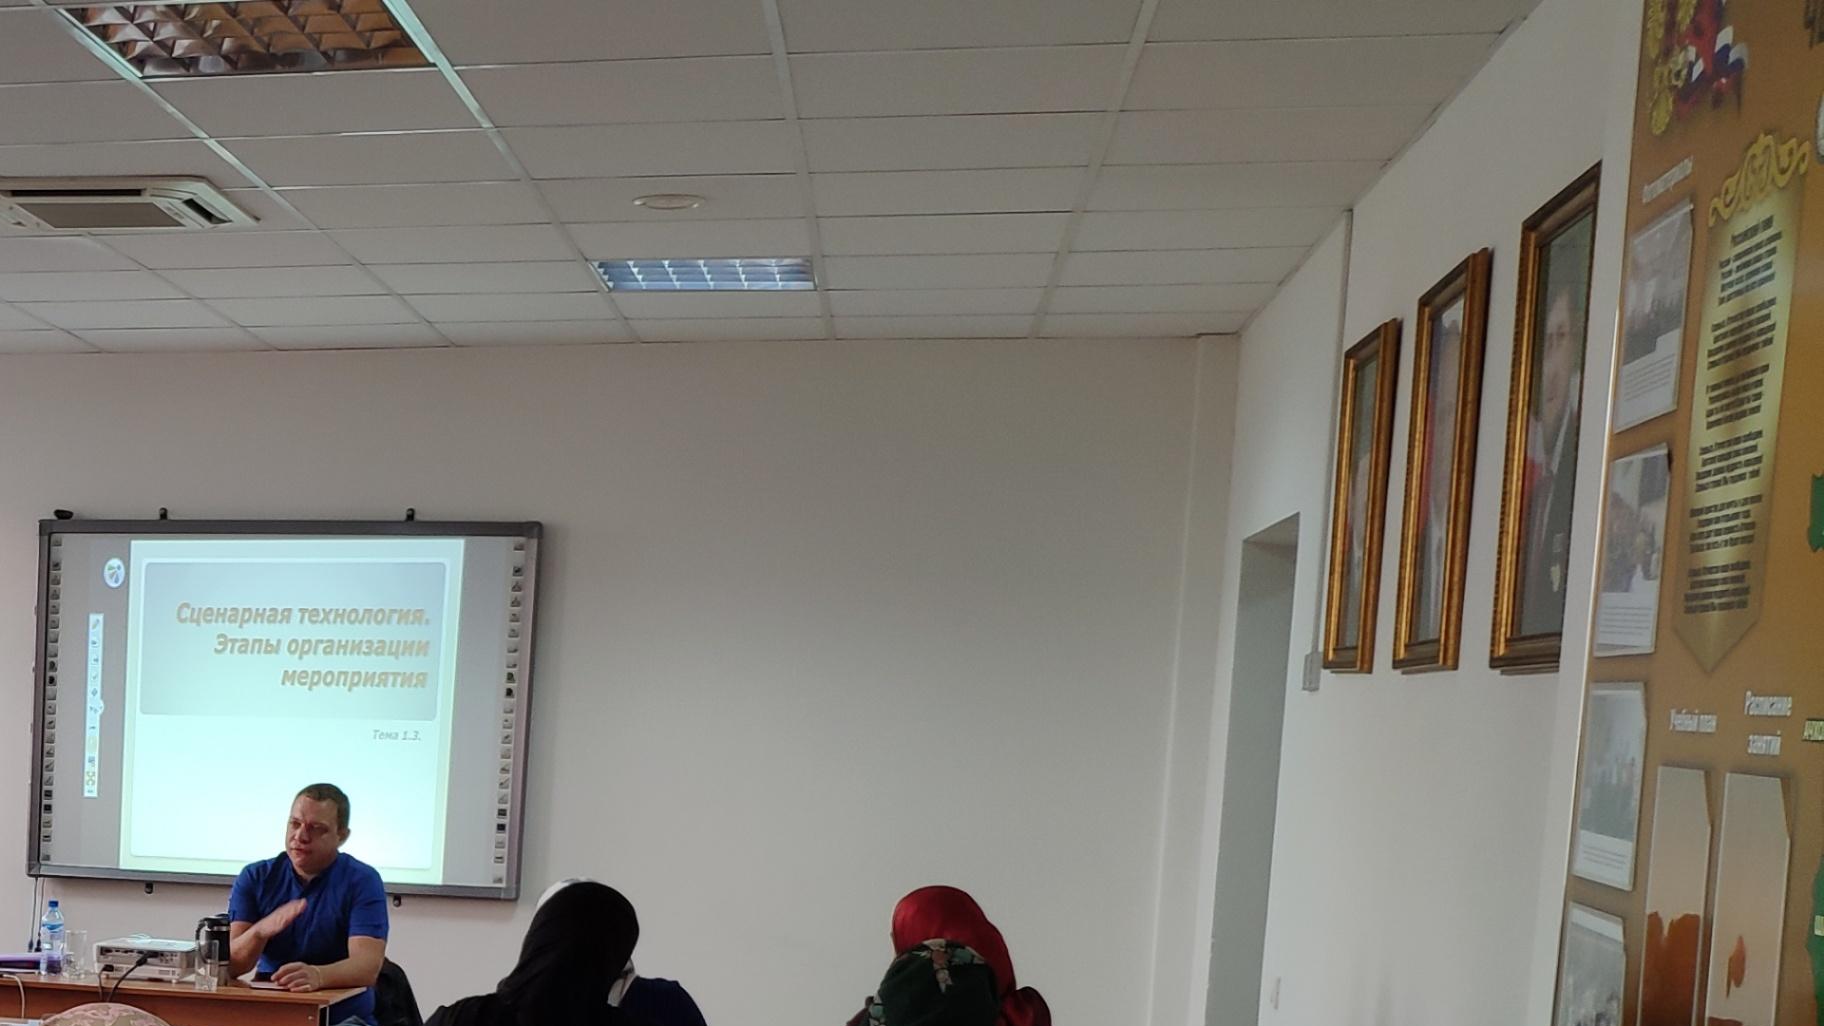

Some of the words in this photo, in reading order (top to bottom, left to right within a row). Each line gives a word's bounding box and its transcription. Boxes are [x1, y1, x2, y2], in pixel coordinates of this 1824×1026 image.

[176, 602, 293, 628] Сценарная
[298, 606, 431, 626] технология.
[214, 633, 281, 656] Этапы
[287, 637, 430, 660] организации
[281, 668, 428, 692] мероприятия
